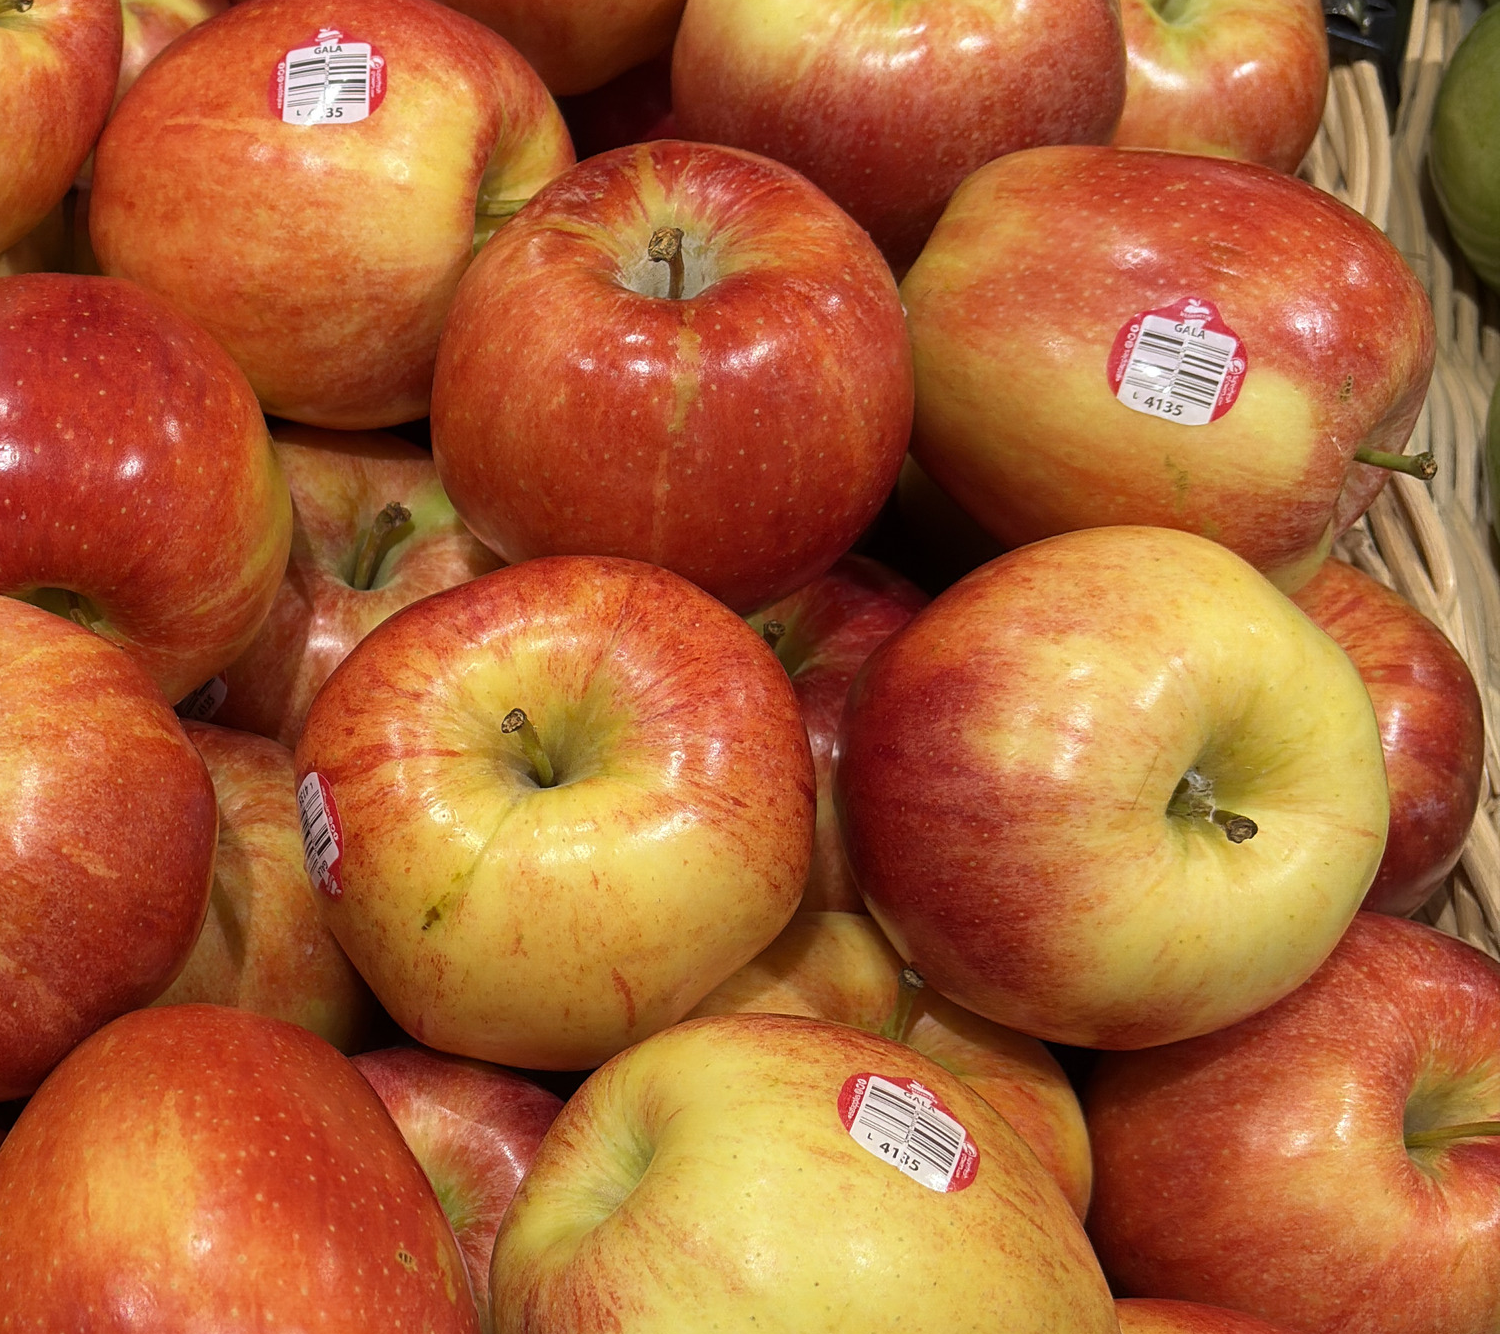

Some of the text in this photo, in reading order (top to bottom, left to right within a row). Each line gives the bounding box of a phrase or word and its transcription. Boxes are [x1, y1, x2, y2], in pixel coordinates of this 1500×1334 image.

[314, 45, 342, 55] GALA
[1174, 323, 1206, 339] GALA
[1144, 396, 1183, 416] 4135
[903, 1091, 936, 1113] GALA
[867, 1132, 921, 1172] L 4135
